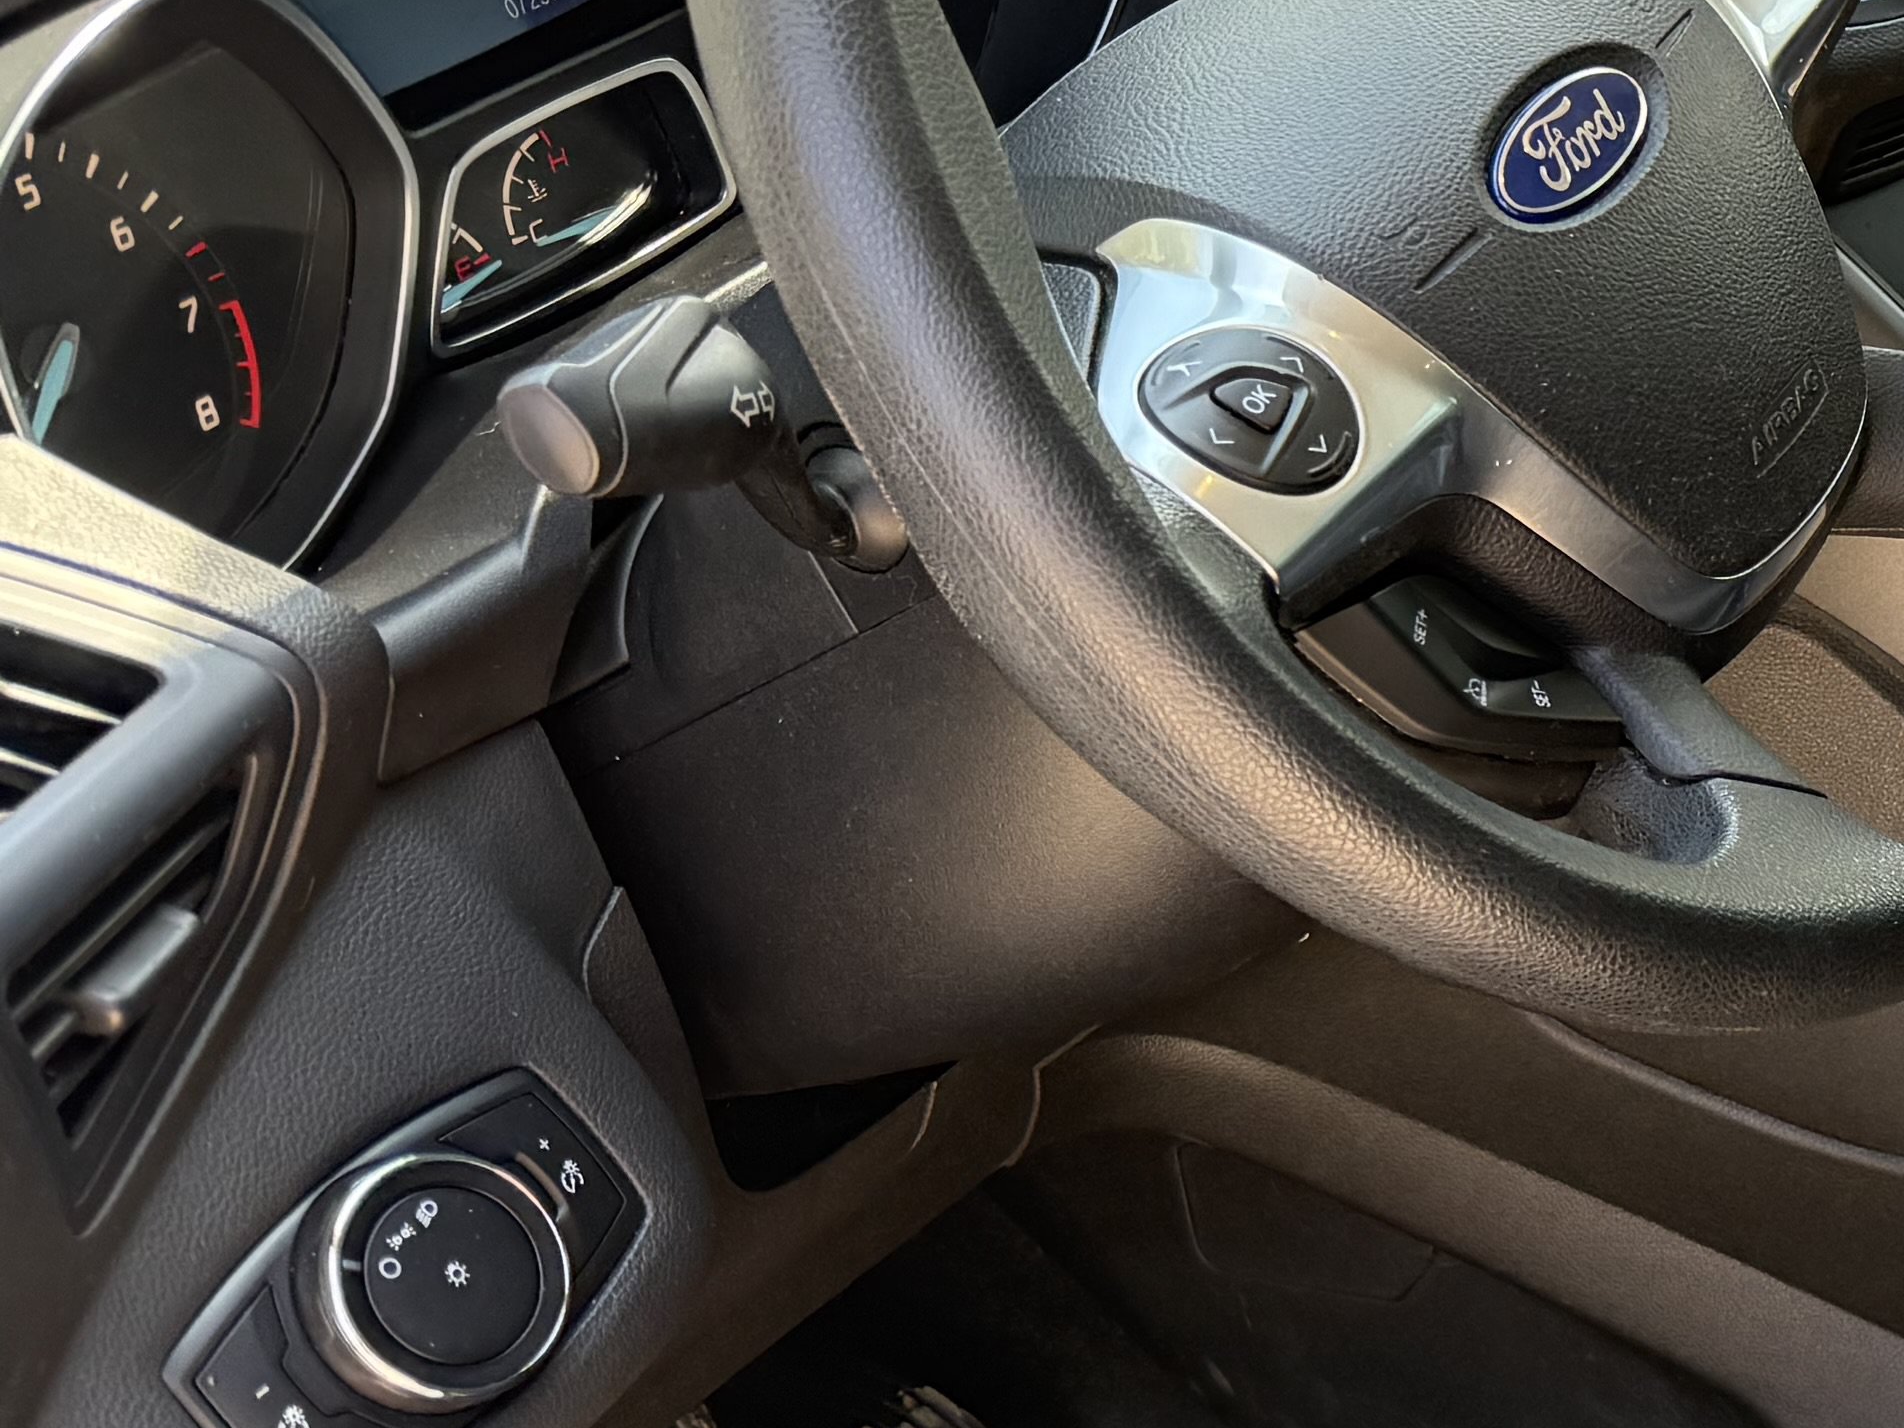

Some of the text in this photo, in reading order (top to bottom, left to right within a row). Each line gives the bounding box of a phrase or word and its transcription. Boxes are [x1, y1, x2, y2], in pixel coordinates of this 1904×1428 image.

[1522, 88, 1626, 192] Ford
[547, 147, 569, 174] H
[14, 173, 42, 211] 5
[109, 216, 136, 252] 6
[178, 295, 198, 334] 7
[194, 394, 221, 432] 8
[1241, 383, 1278, 415] OK
